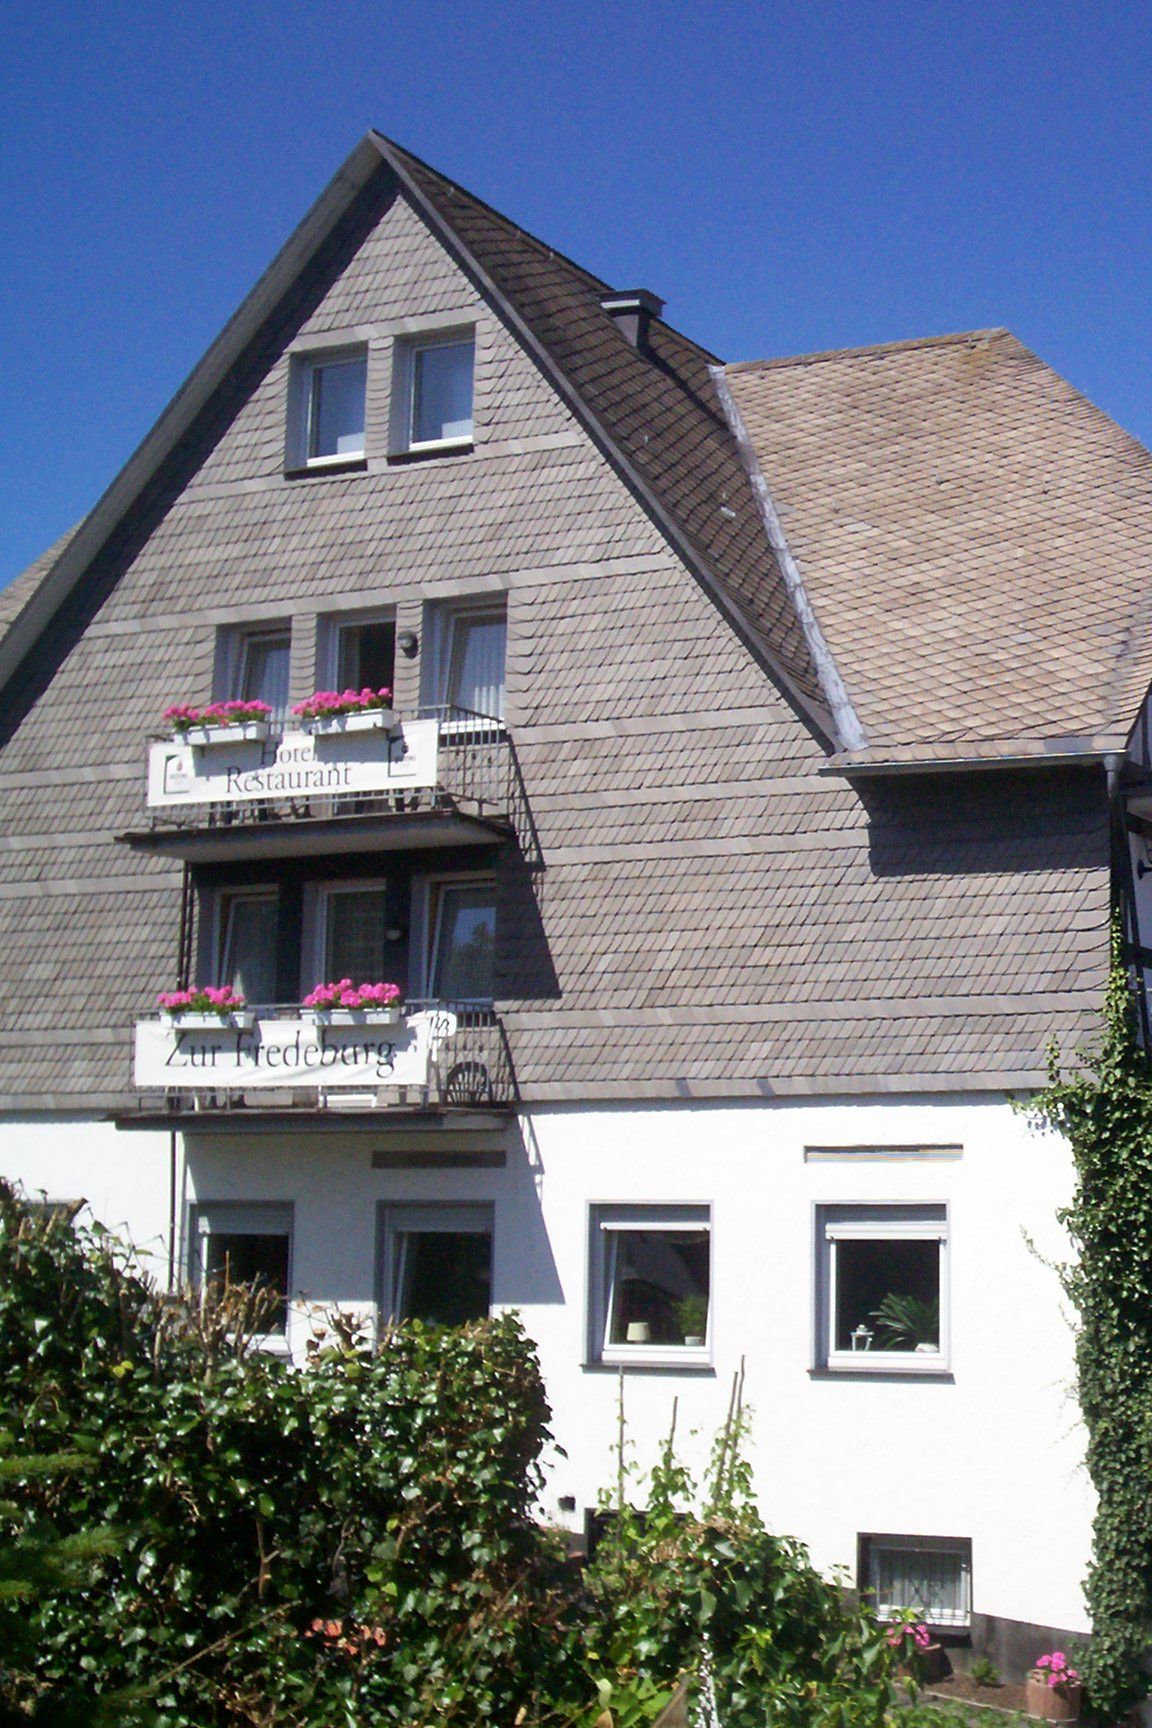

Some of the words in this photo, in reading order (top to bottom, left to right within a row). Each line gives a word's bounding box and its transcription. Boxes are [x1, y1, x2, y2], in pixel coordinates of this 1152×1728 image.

[261, 740, 317, 766] Hotel
[226, 764, 352, 795] Restaurant
[165, 1031, 217, 1068] Zur
[235, 1029, 396, 1079] Fredeburg
